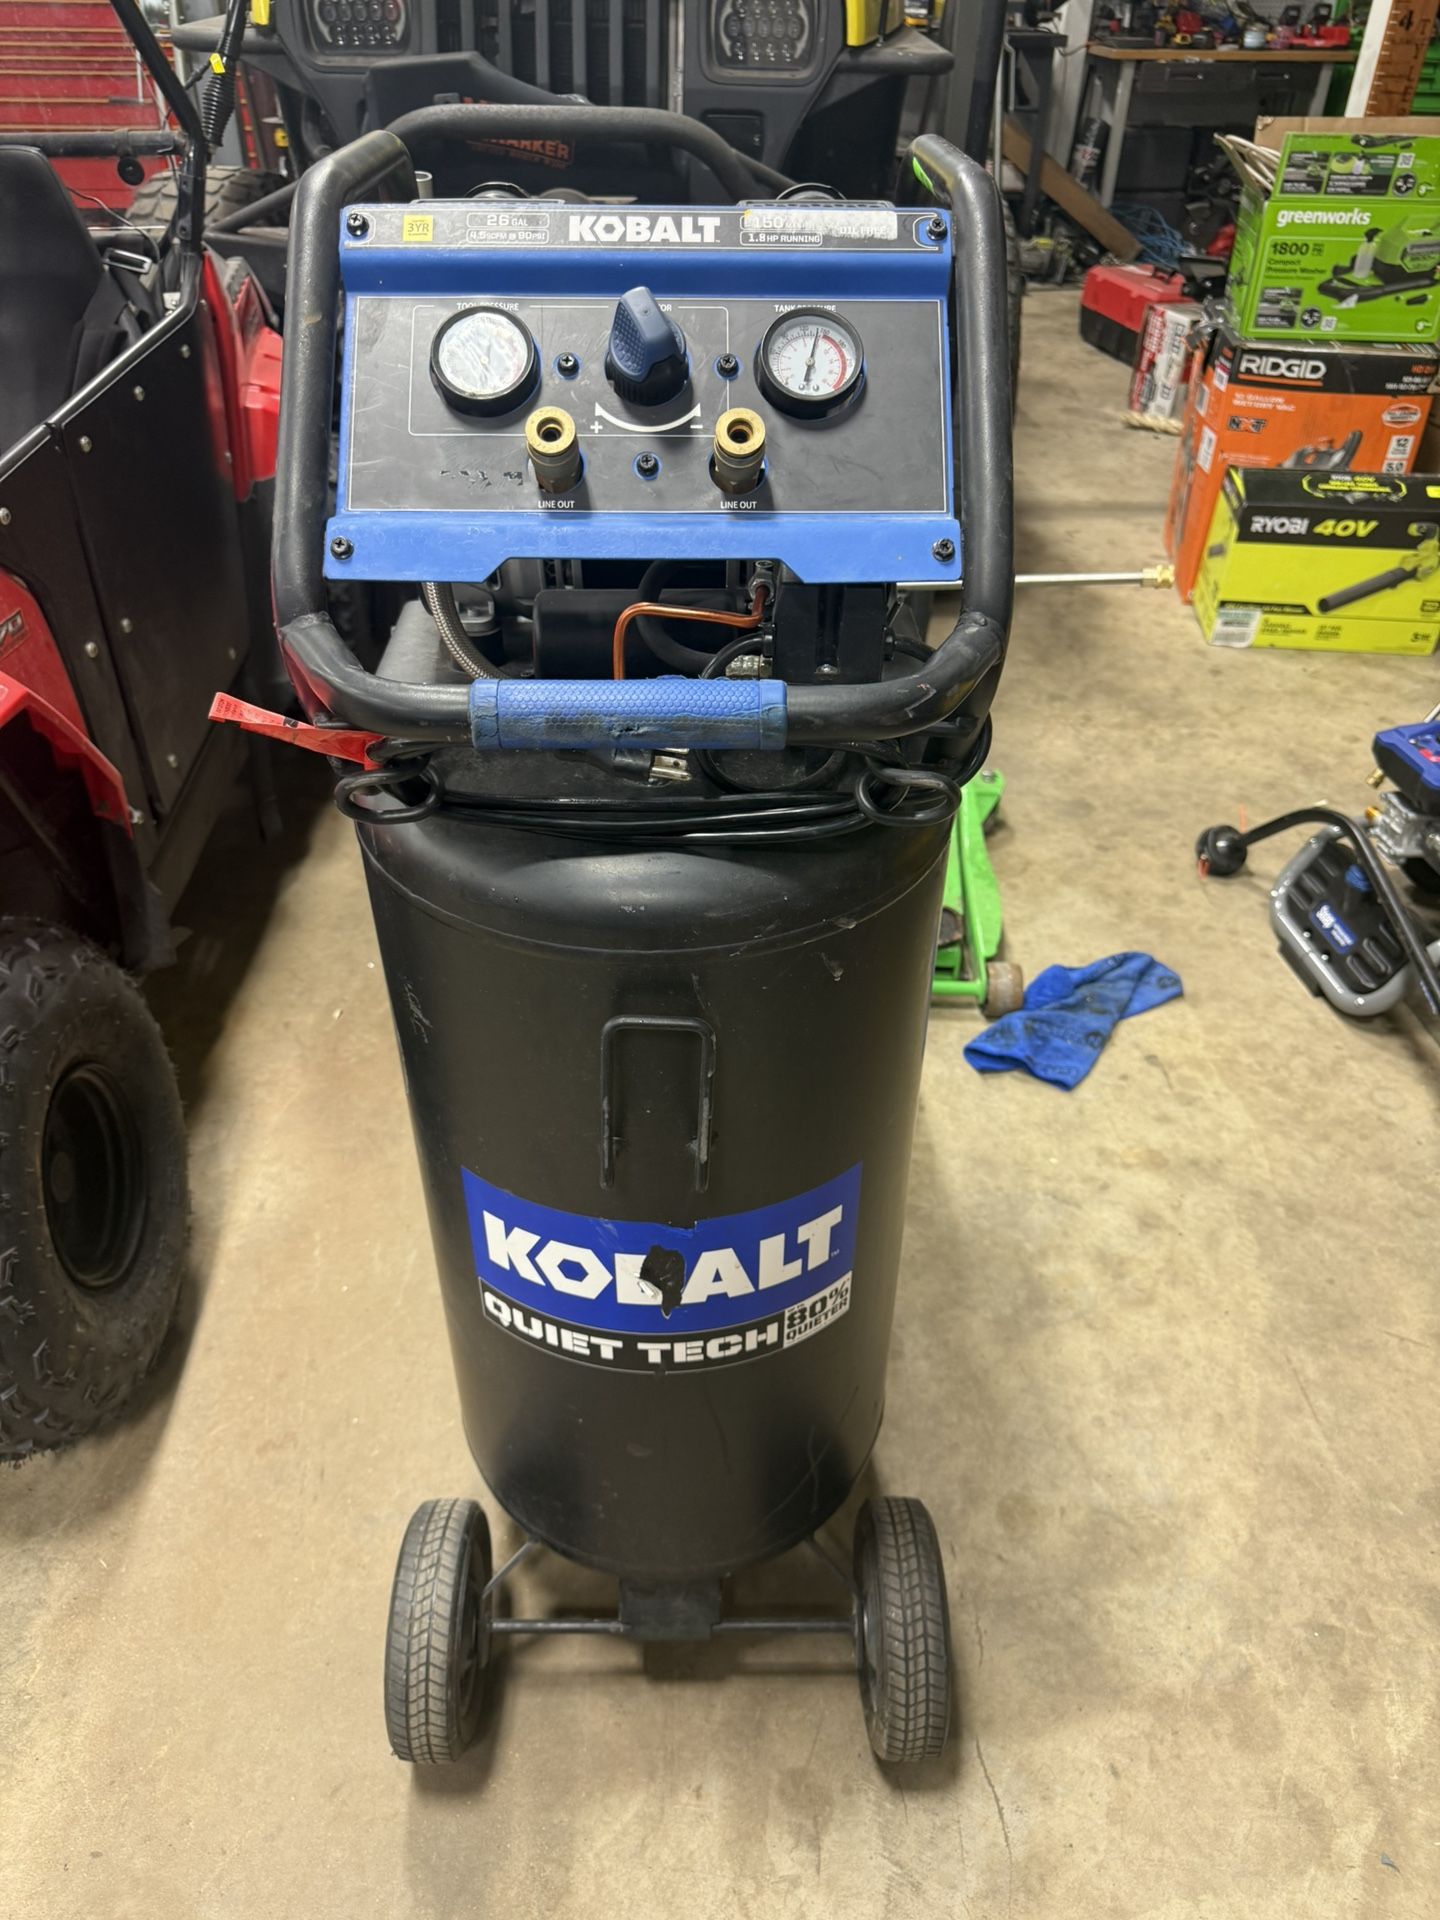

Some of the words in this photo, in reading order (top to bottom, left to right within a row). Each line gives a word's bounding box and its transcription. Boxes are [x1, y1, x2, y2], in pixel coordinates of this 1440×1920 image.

[486, 214, 510, 226] 26
[511, 218, 529, 227] GAL
[1277, 208, 1371, 227] greenworks
[408, 222, 430, 233] 3YR
[568, 215, 720, 243] KOBALT
[748, 233, 766, 243] 1.8
[780, 234, 820, 243] RUNNING
[1271, 242, 1310, 256] 1800
[1239, 355, 1328, 380] RIDGID
[537, 501, 556, 509] LINE
[557, 501, 575, 509] OUT
[720, 501, 738, 509] LINE
[740, 501, 757, 509] OUT
[1250, 516, 1310, 535] RYOBI
[1313, 519, 1378, 537] 40V
[787, 1277, 849, 1330] 80%
[485, 1290, 623, 1360] QUIET
[637, 1323, 779, 1364] TECH
[786, 1297, 848, 1341] QUIETER
